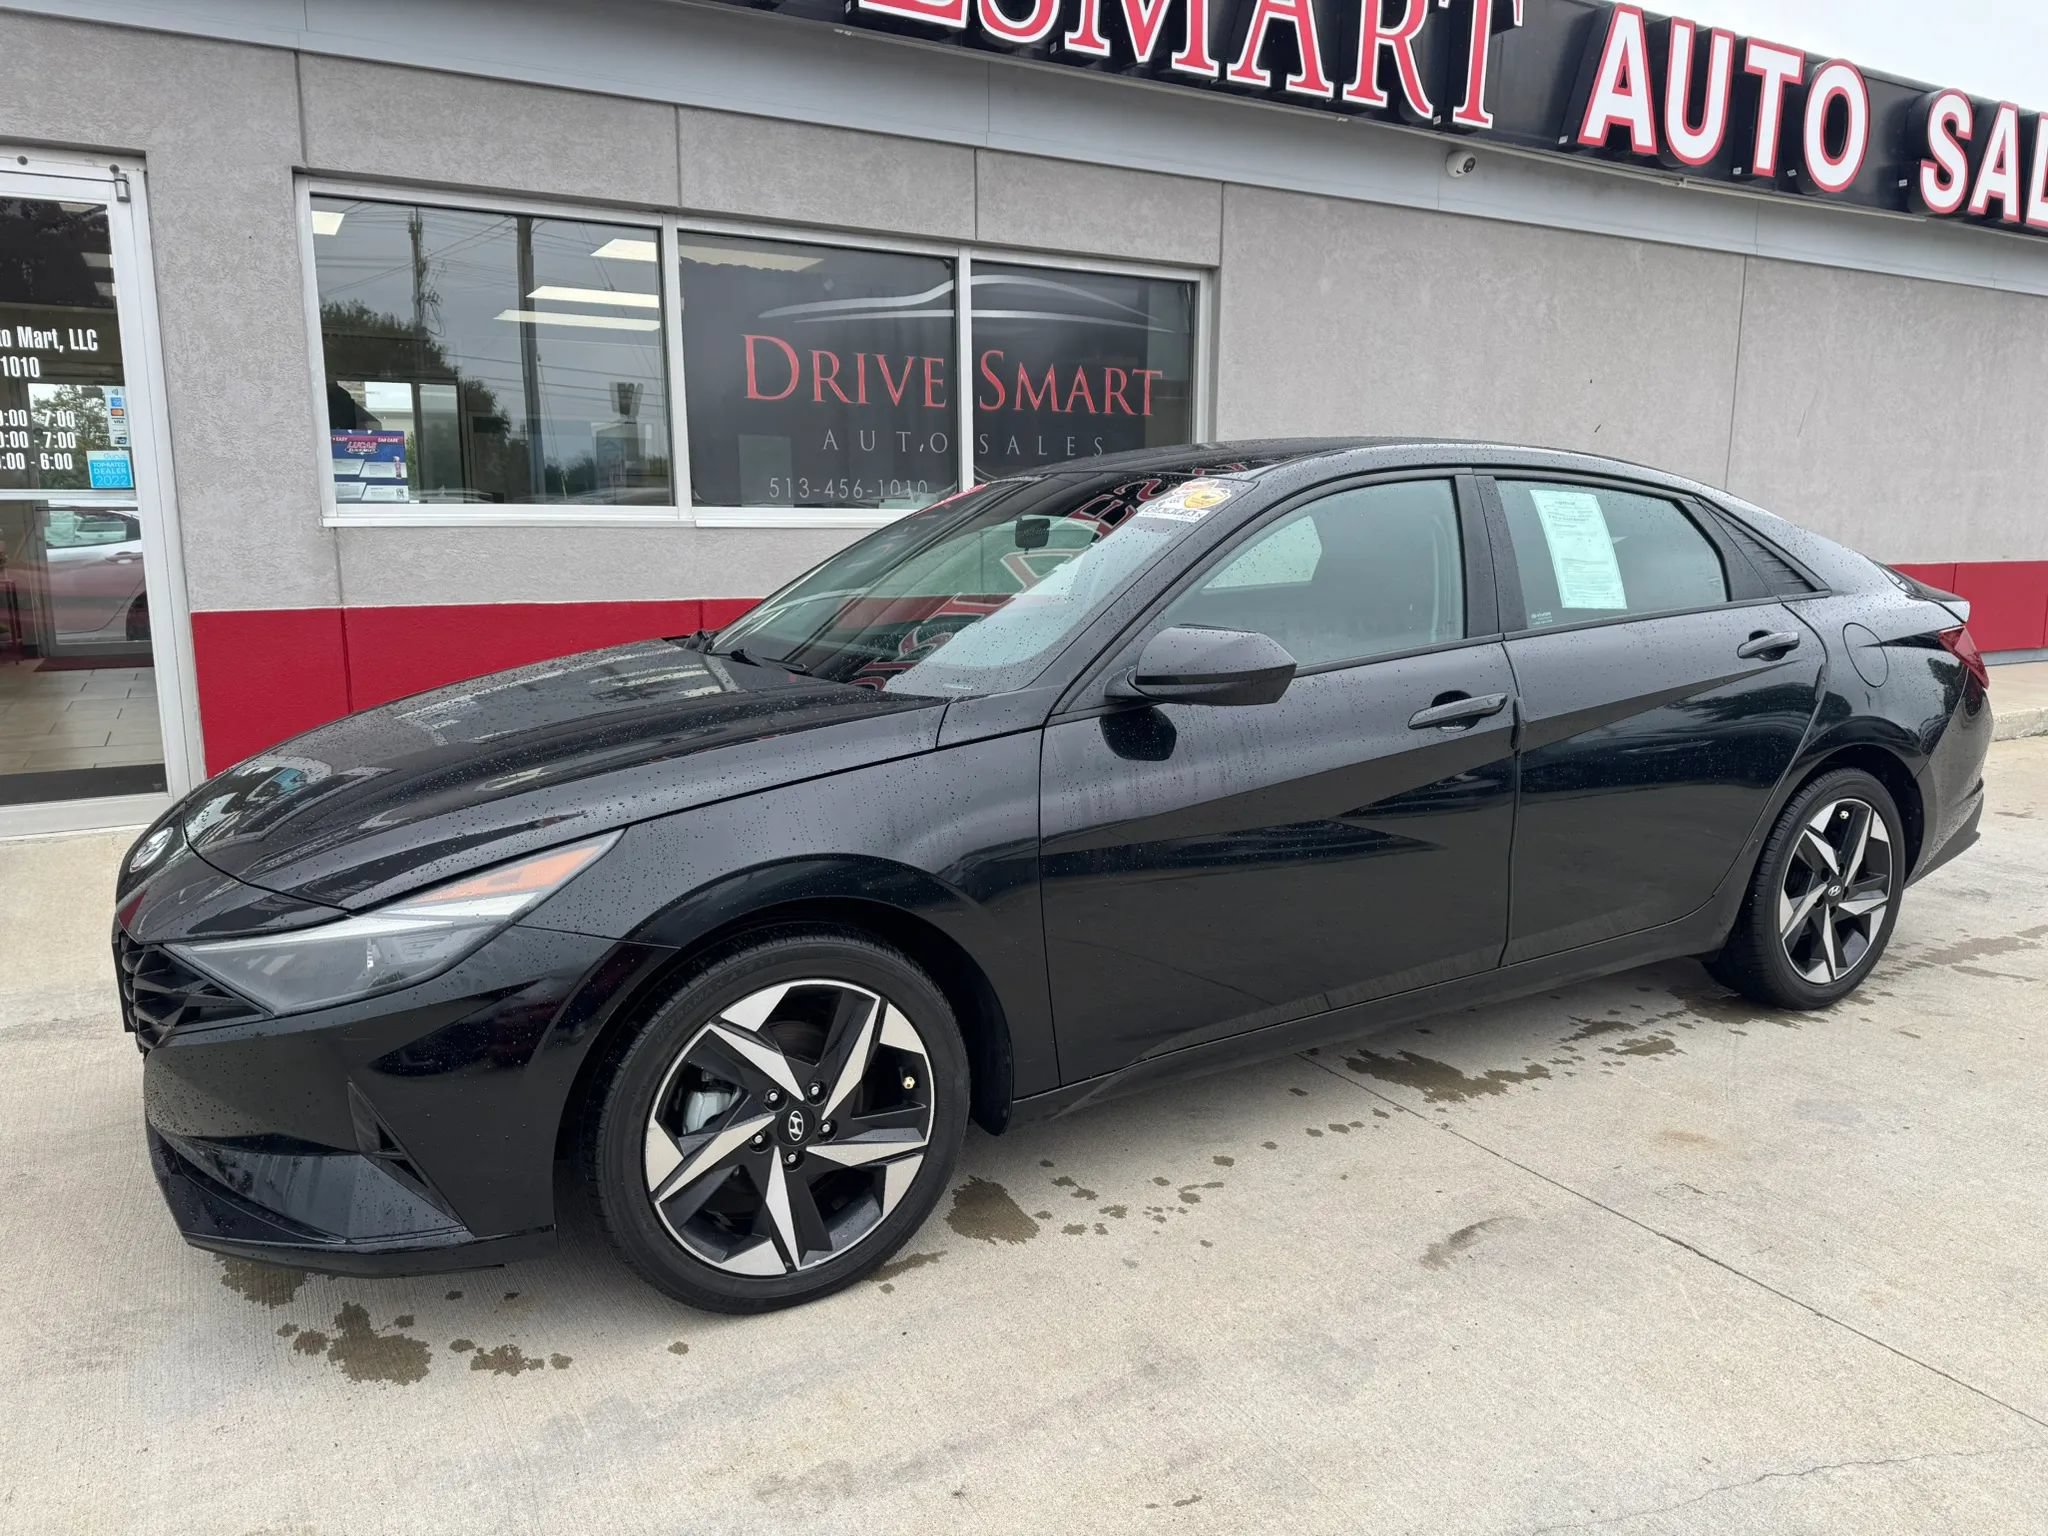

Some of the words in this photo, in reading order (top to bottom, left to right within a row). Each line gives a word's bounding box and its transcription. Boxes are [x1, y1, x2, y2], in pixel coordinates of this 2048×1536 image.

[858, 0, 1523, 129] MART
[1577, 3, 1871, 193] AUTO
[16, 325, 64, 353] Mart,
[68, 328, 99, 351] LLC
[0, 355, 41, 378] 1010
[740, 333, 948, 408] DRIVE
[978, 348, 1163, 417] SMART
[41, 409, 76, 428] 7:00
[42, 431, 77, 449] 7:00
[822, 428, 949, 455] AUTO
[979, 432, 1105, 457] SALES
[0, 452, 26, 470] :00
[40, 452, 73, 470] 6:00
[95, 475, 128, 486] 2022
[767, 476, 929, 499] 513-456-1010
